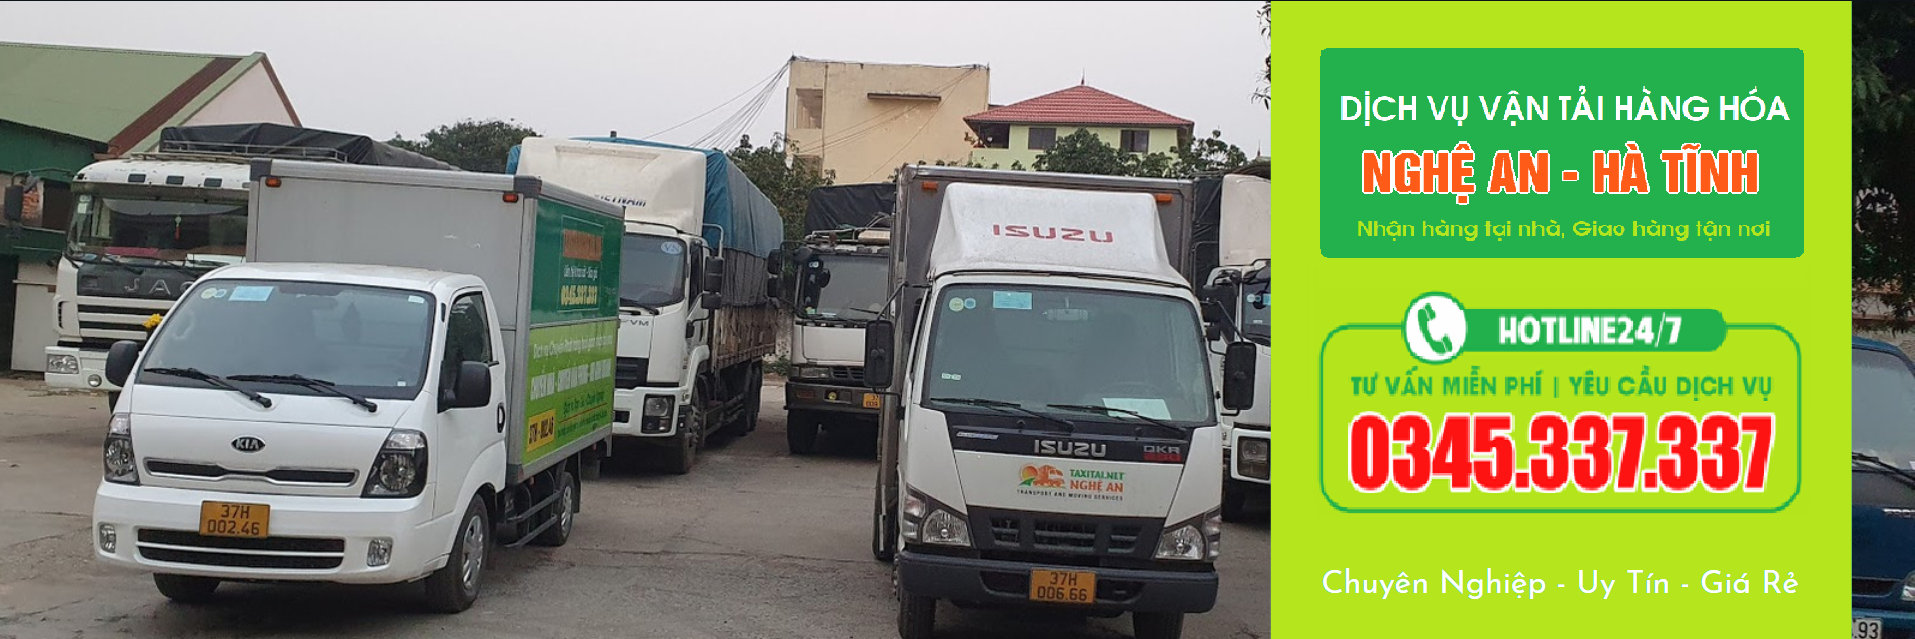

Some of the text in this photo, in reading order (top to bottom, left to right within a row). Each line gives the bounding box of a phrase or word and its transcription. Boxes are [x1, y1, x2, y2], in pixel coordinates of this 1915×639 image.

[993, 224, 1113, 243] ISUZU
[235, 438, 259, 449] KIA
[1034, 439, 1106, 458] ISUZU
[1106, 482, 1123, 492] AN
[221, 504, 250, 519] 37H
[207, 519, 260, 535] 002.46
[1050, 572, 1077, 586] 37H
[1038, 585, 1087, 601] 006.66
